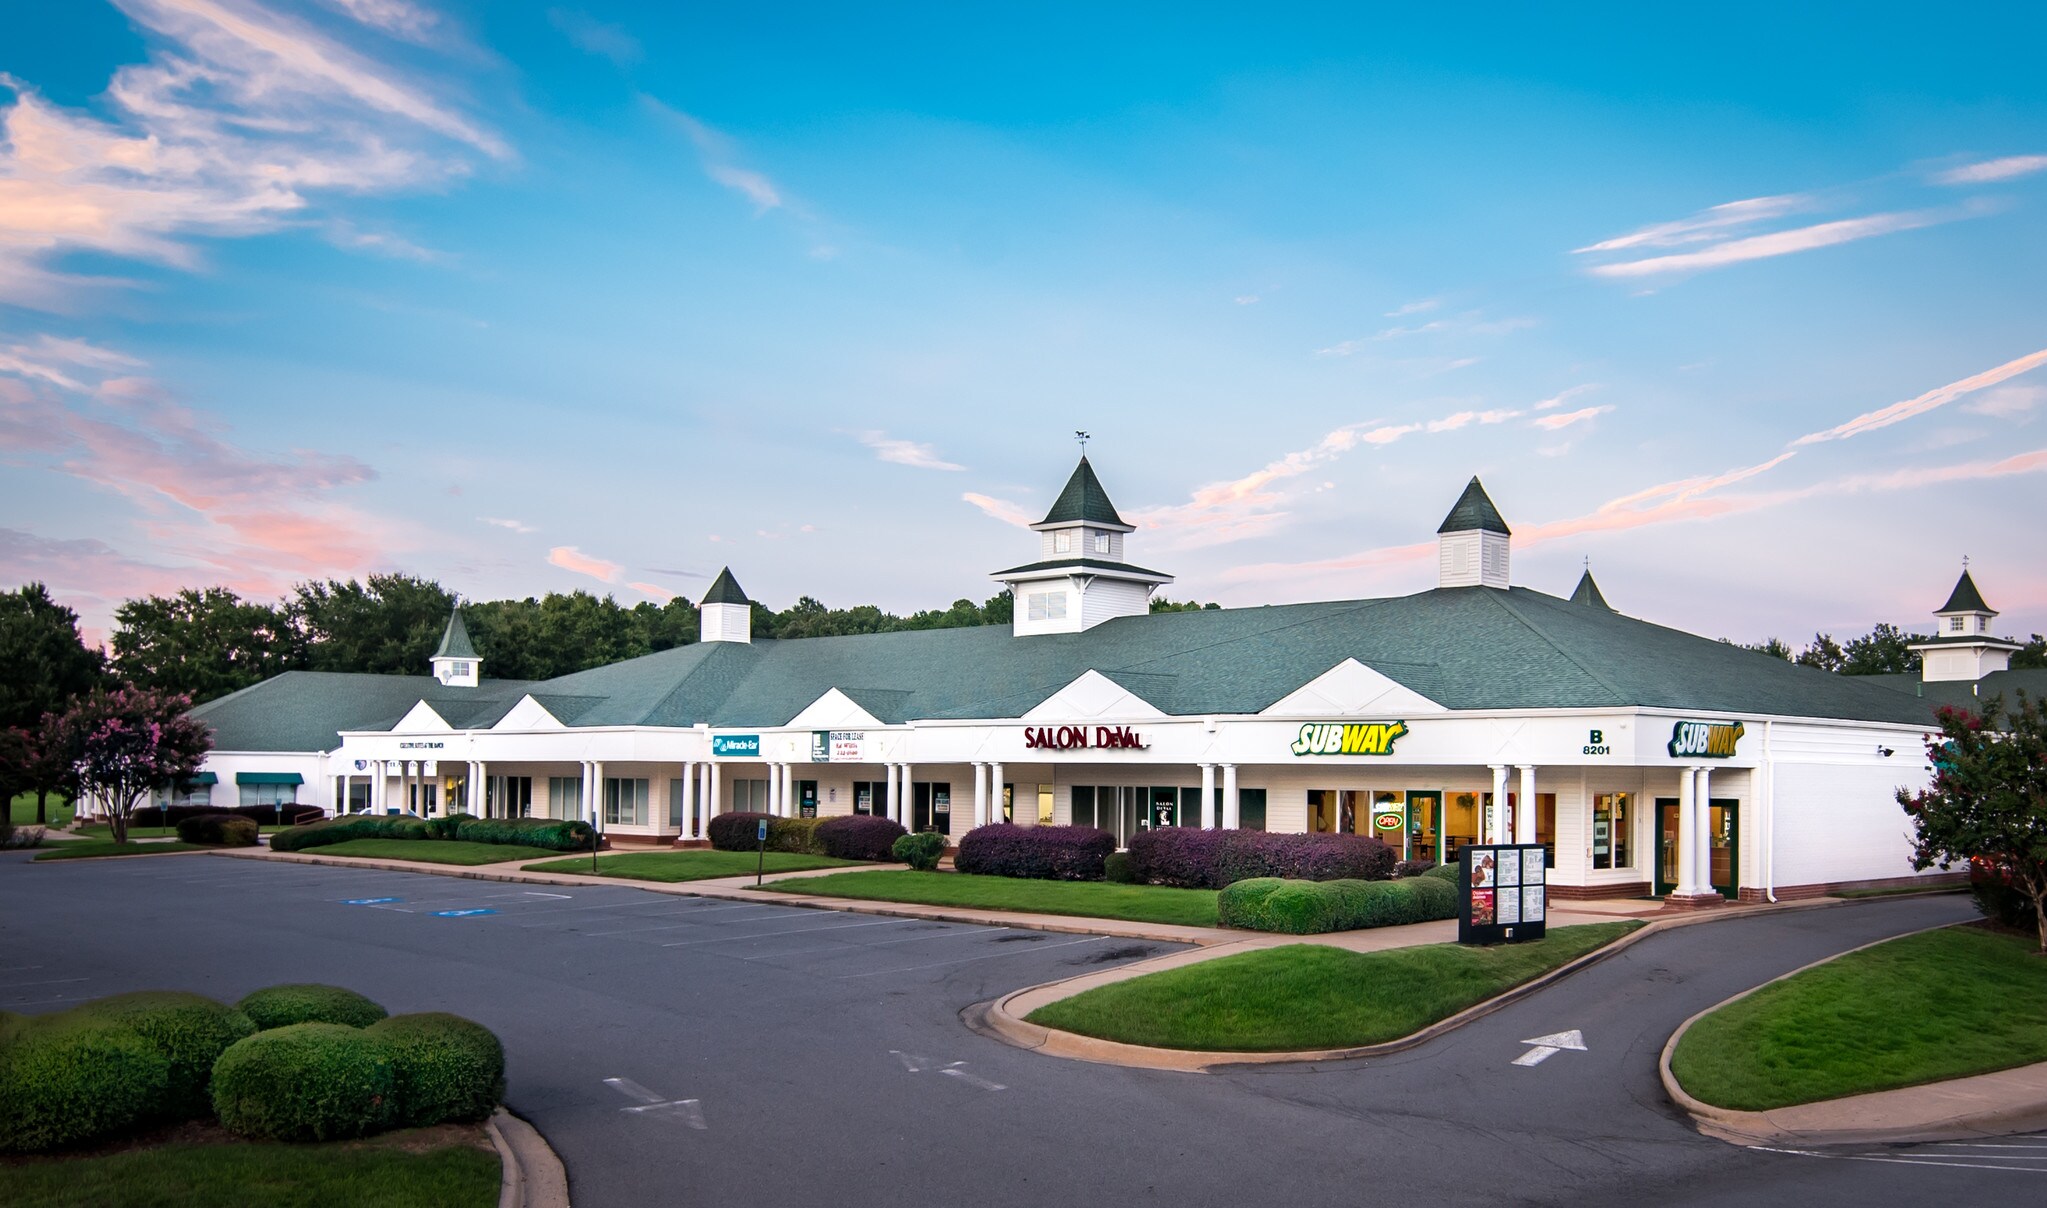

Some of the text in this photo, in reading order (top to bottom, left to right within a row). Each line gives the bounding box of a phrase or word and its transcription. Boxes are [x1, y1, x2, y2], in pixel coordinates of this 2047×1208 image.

[1024, 726, 1088, 748] SALON
[1292, 722, 1404, 753] SUBWAY
[1590, 729, 1603, 744] B
[1675, 722, 1743, 754] SUBWAY
[1583, 745, 1610, 755] 8201
[1378, 815, 1399, 826] OPEN
